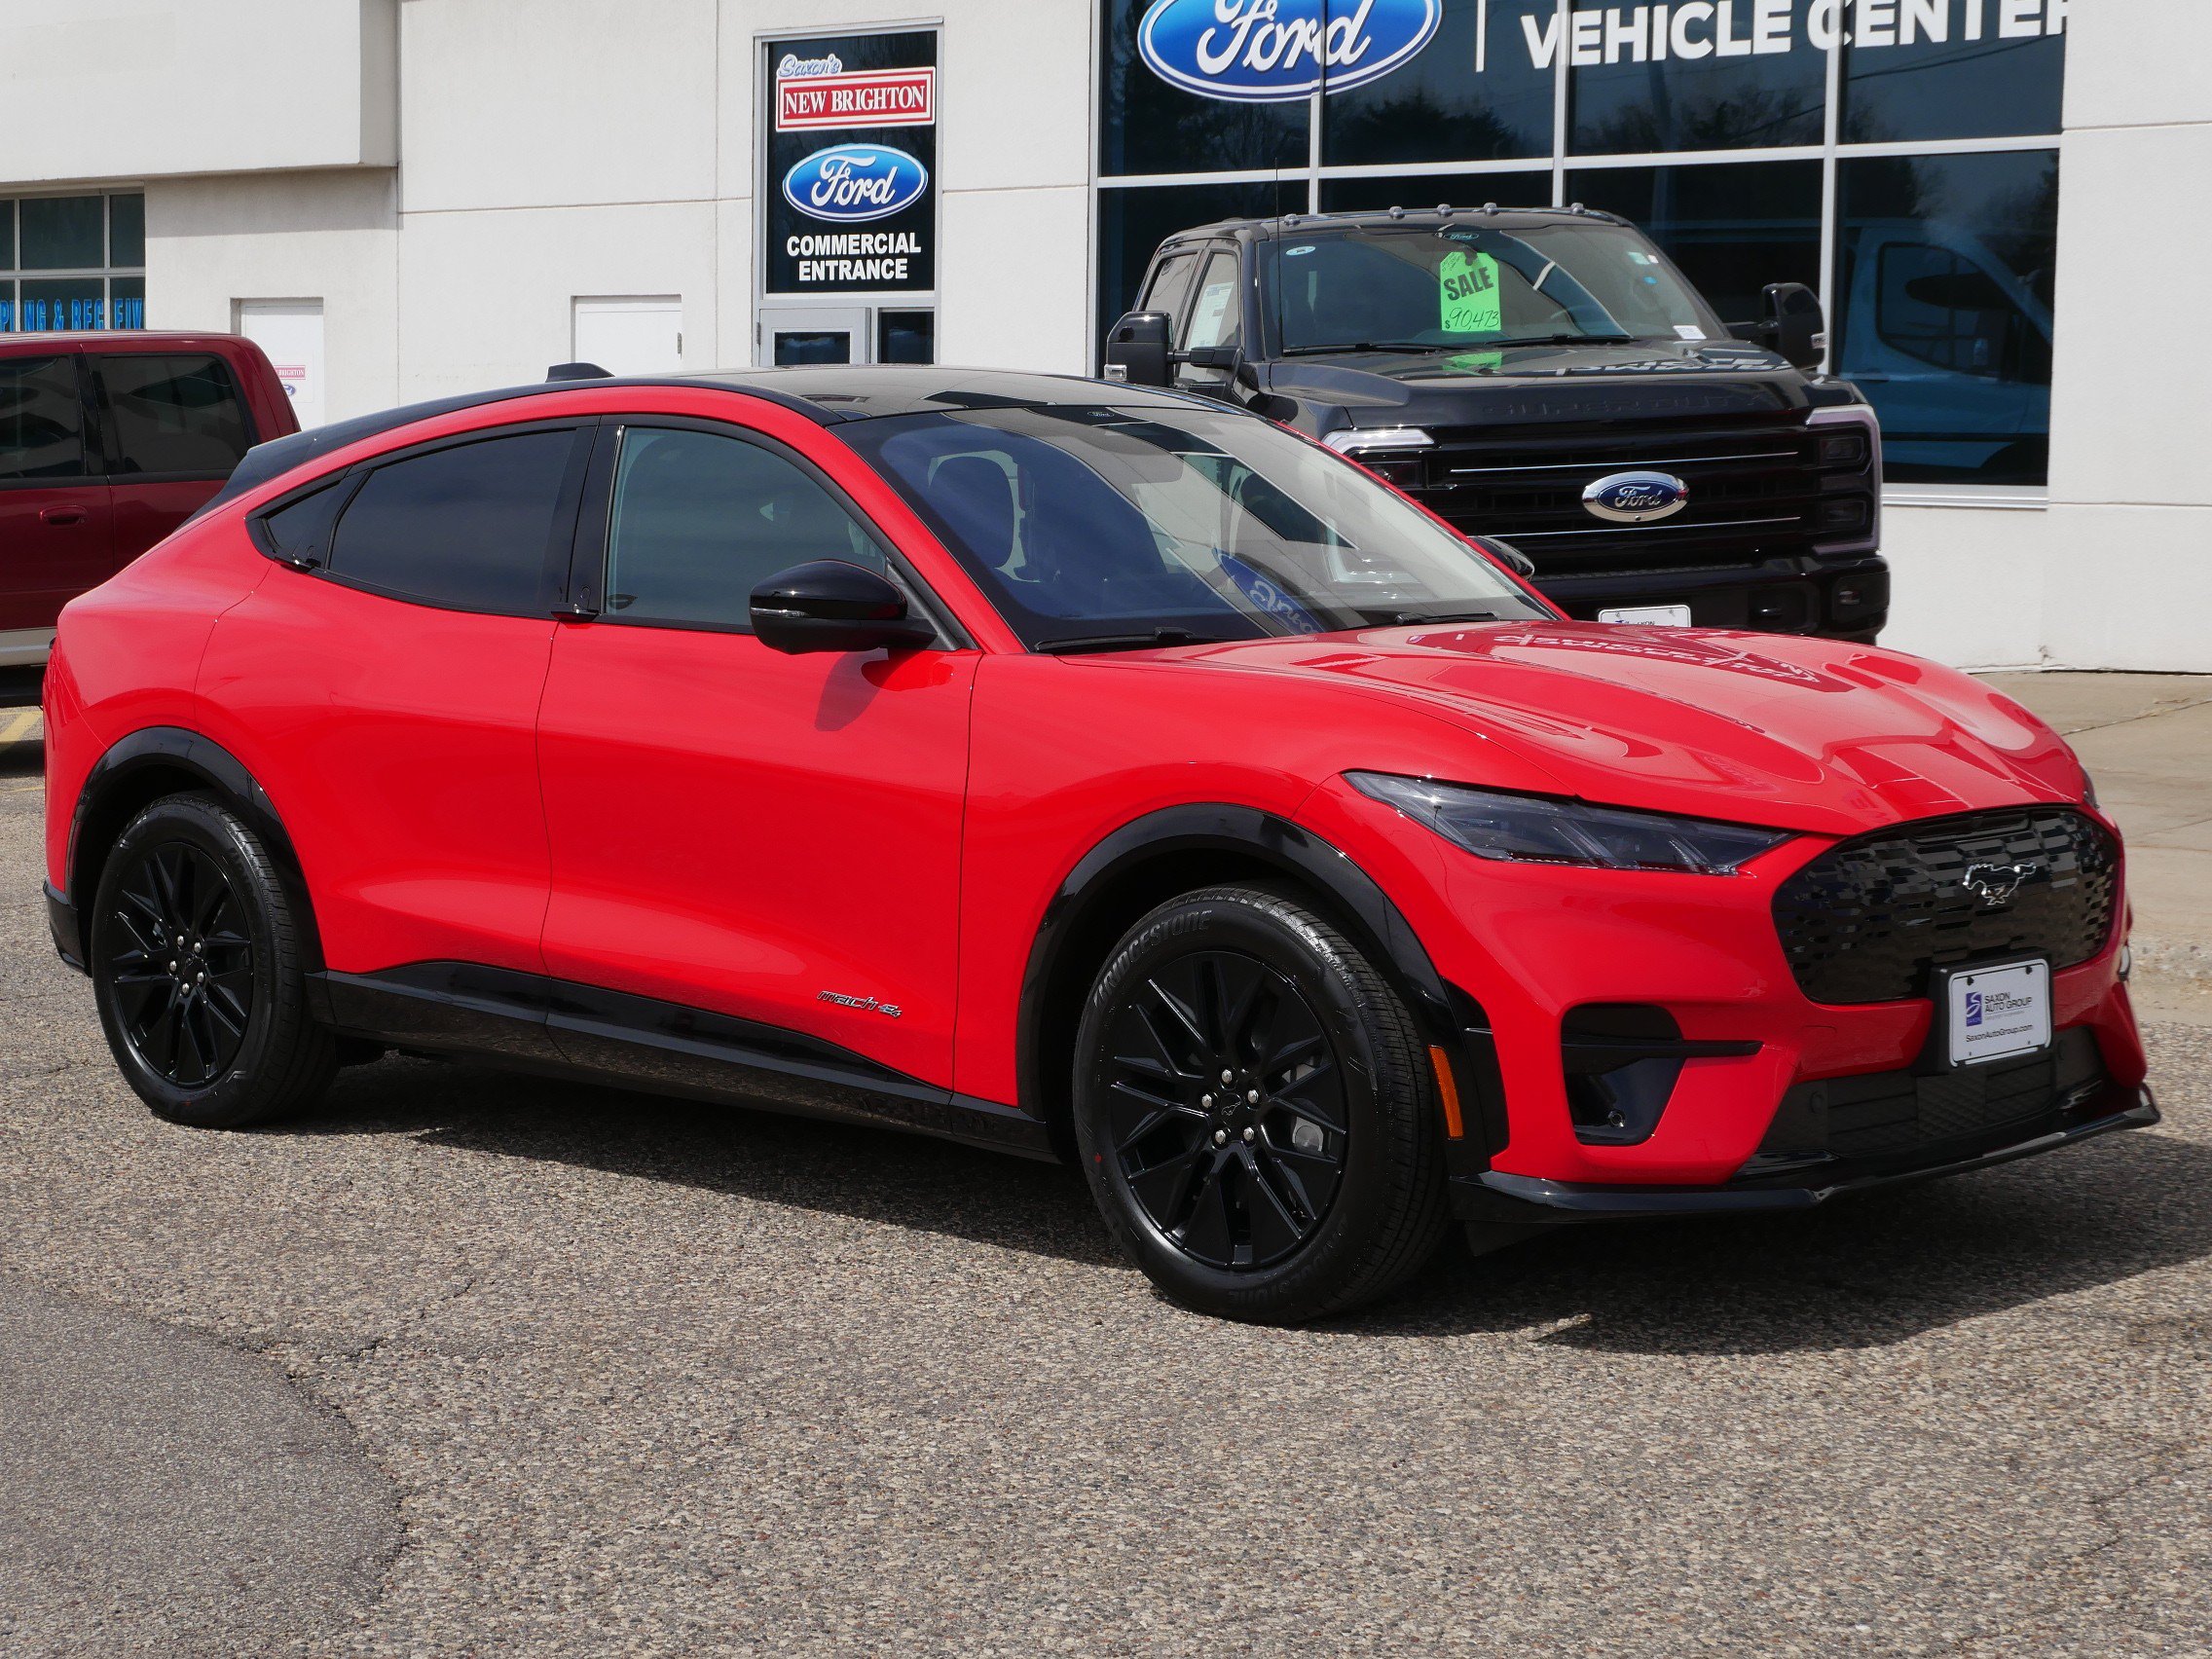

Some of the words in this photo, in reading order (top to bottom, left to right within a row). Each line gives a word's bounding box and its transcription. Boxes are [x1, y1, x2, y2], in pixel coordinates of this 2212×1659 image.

[1196, 0, 1372, 75] Ford
[1521, 0, 1791, 69] VEHICLE
[779, 55, 840, 77] Saxon's
[785, 92, 827, 114] NEW
[831, 85, 925, 112] BRIGHTON
[811, 155, 898, 206] Ford
[787, 233, 921, 256] COMMERCIAL
[798, 258, 907, 281] ENTRANCE
[1443, 266, 1494, 301] SALE
[54, 299, 64, 330] &
[1614, 485, 1663, 507] Ford
[1984, 991, 2010, 1004] SAXON
[1985, 1002, 2006, 1013] AUTO
[2006, 996, 2033, 1010] GROUP
[1966, 1023, 2034, 1043] SaxonAutoGroup.com
